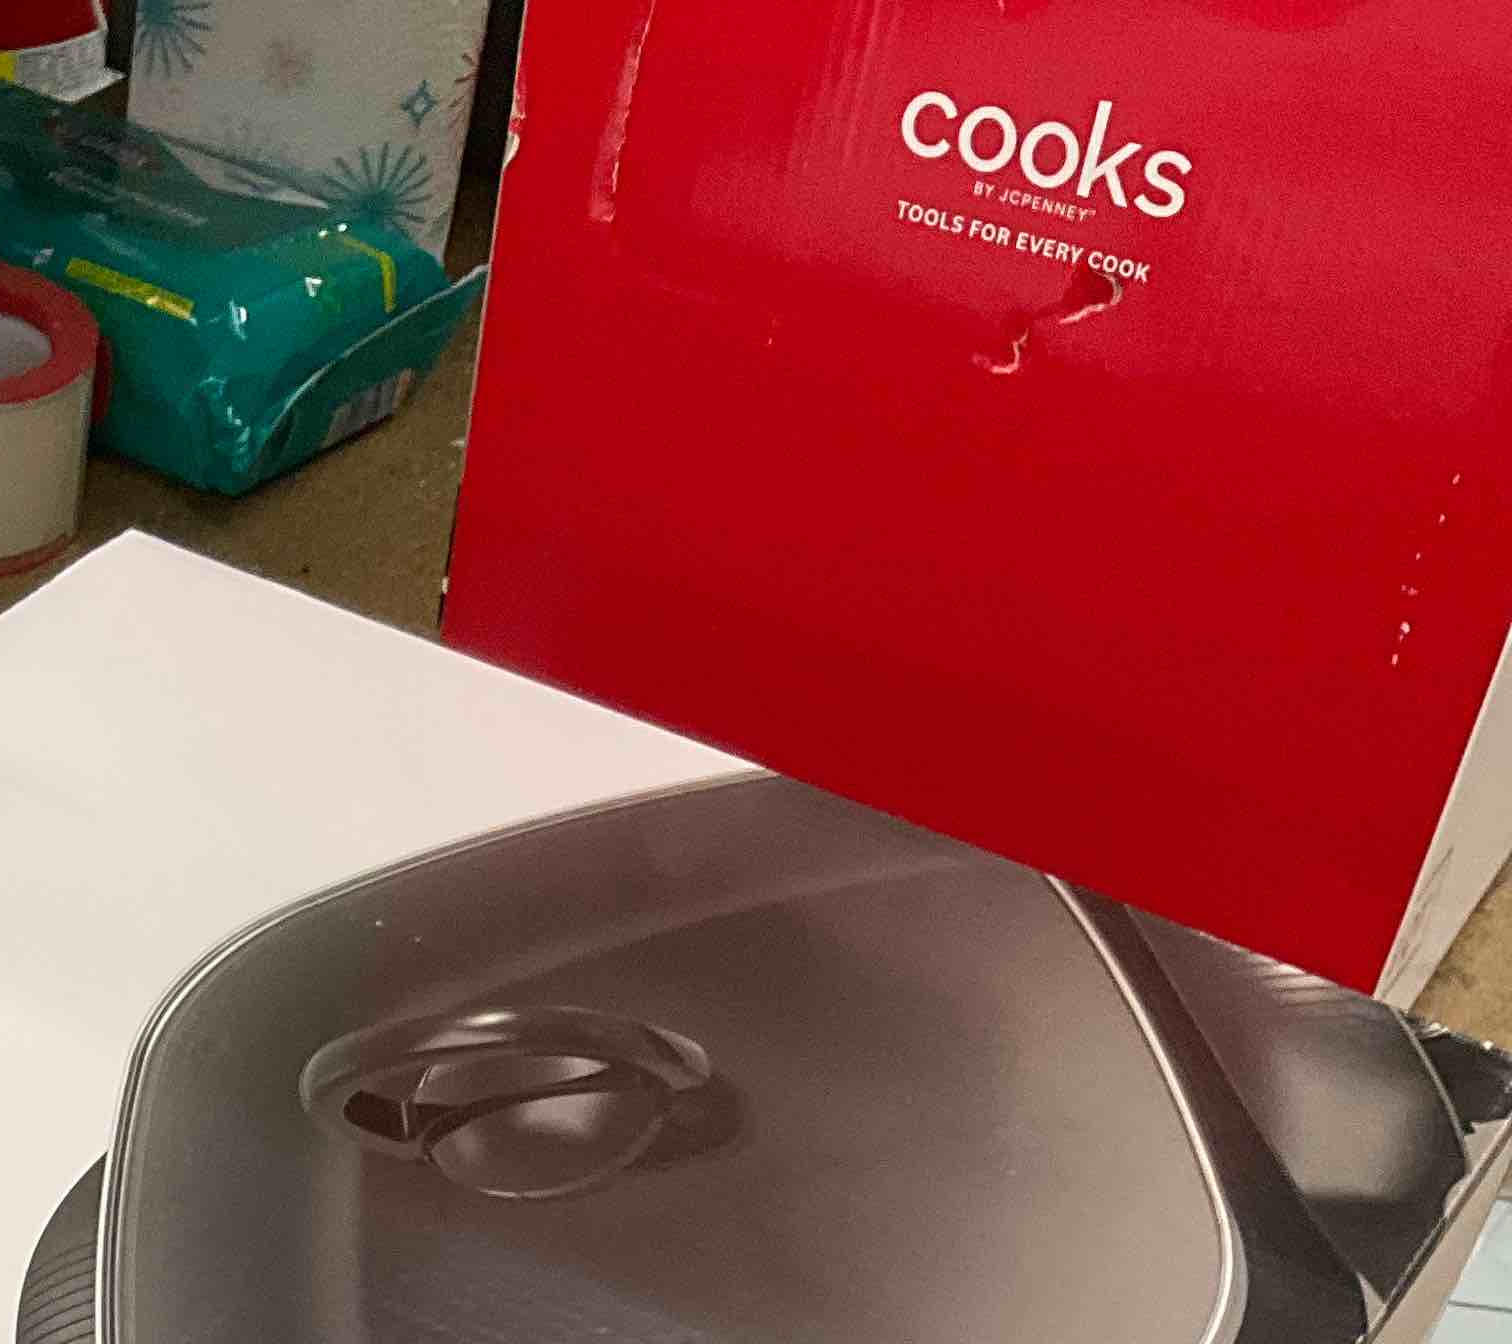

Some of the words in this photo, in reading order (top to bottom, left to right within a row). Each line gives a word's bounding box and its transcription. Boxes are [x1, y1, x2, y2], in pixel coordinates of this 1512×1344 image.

[900, 91, 1193, 218] cooks
[973, 180, 995, 198] BY
[897, 199, 965, 234] TOOLS
[969, 219, 1011, 246] FOR
[1015, 231, 1085, 265] EVERY
[1088, 250, 1151, 284] COOK
